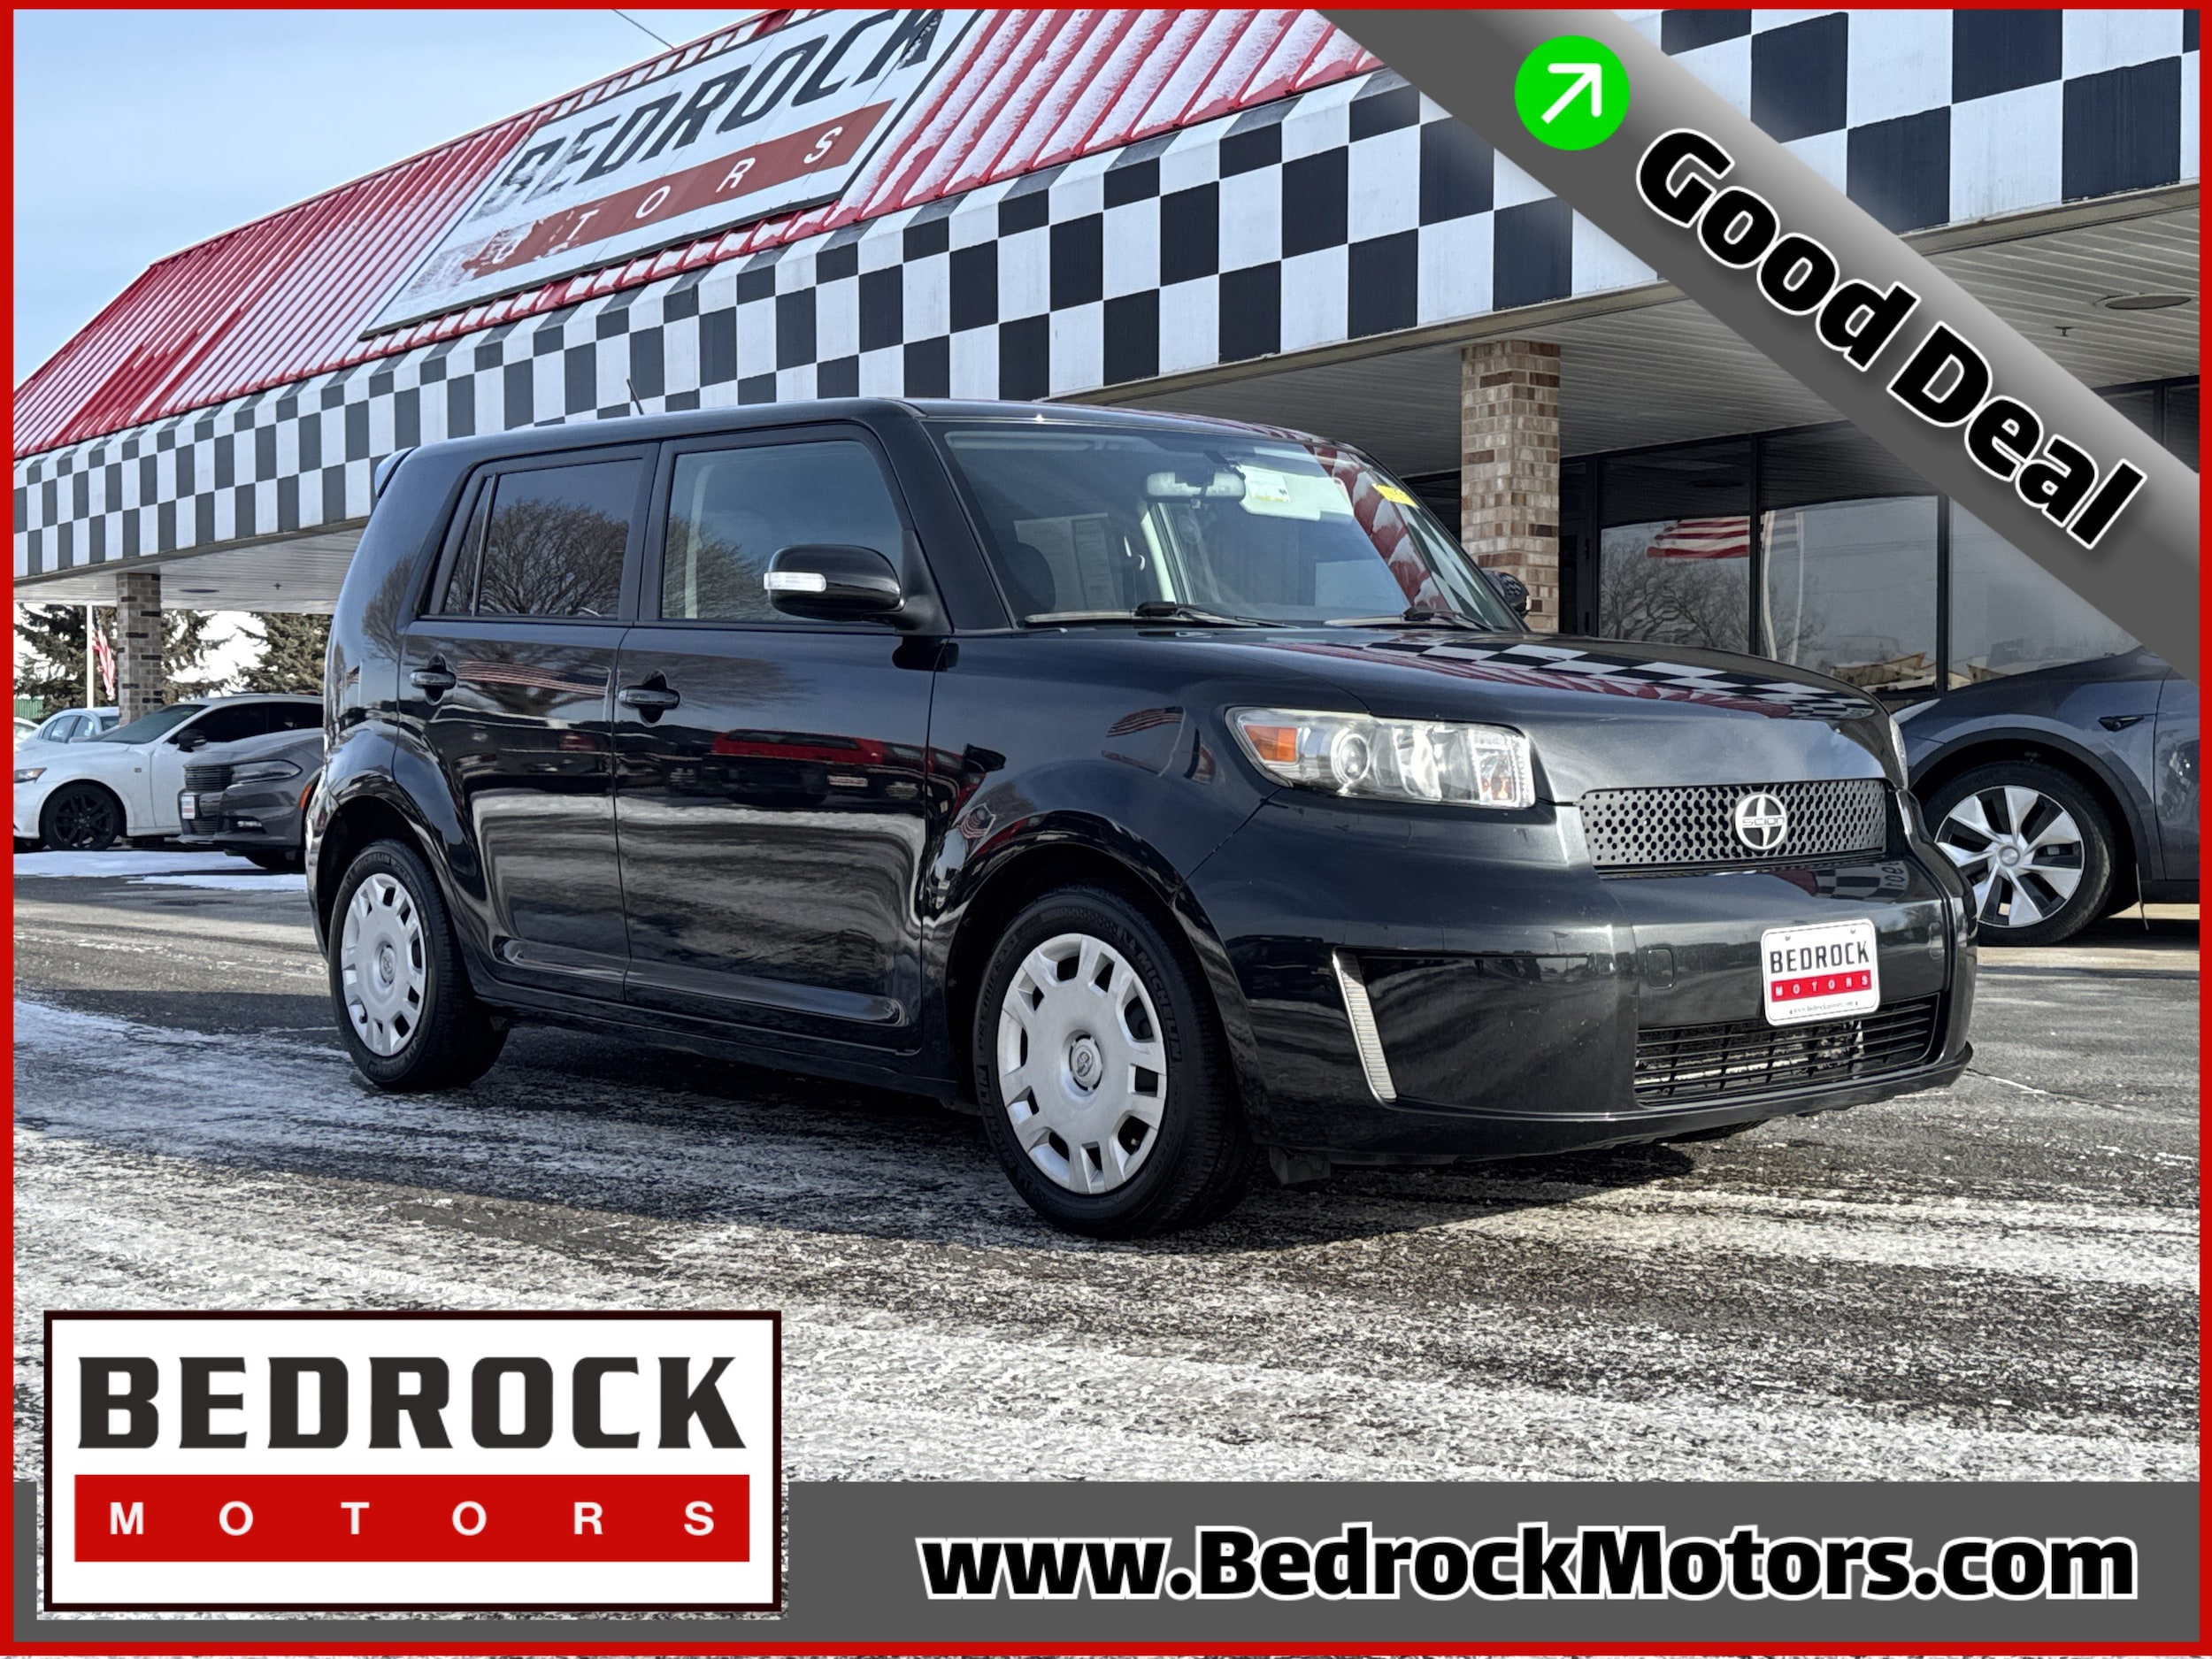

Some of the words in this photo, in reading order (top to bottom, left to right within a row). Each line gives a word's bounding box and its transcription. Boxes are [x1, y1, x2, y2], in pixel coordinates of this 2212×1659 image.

[1742, 817, 1785, 826] SCION
[1770, 941, 1870, 974] BEDROCK
[1775, 975, 1868, 997] MOTORS
